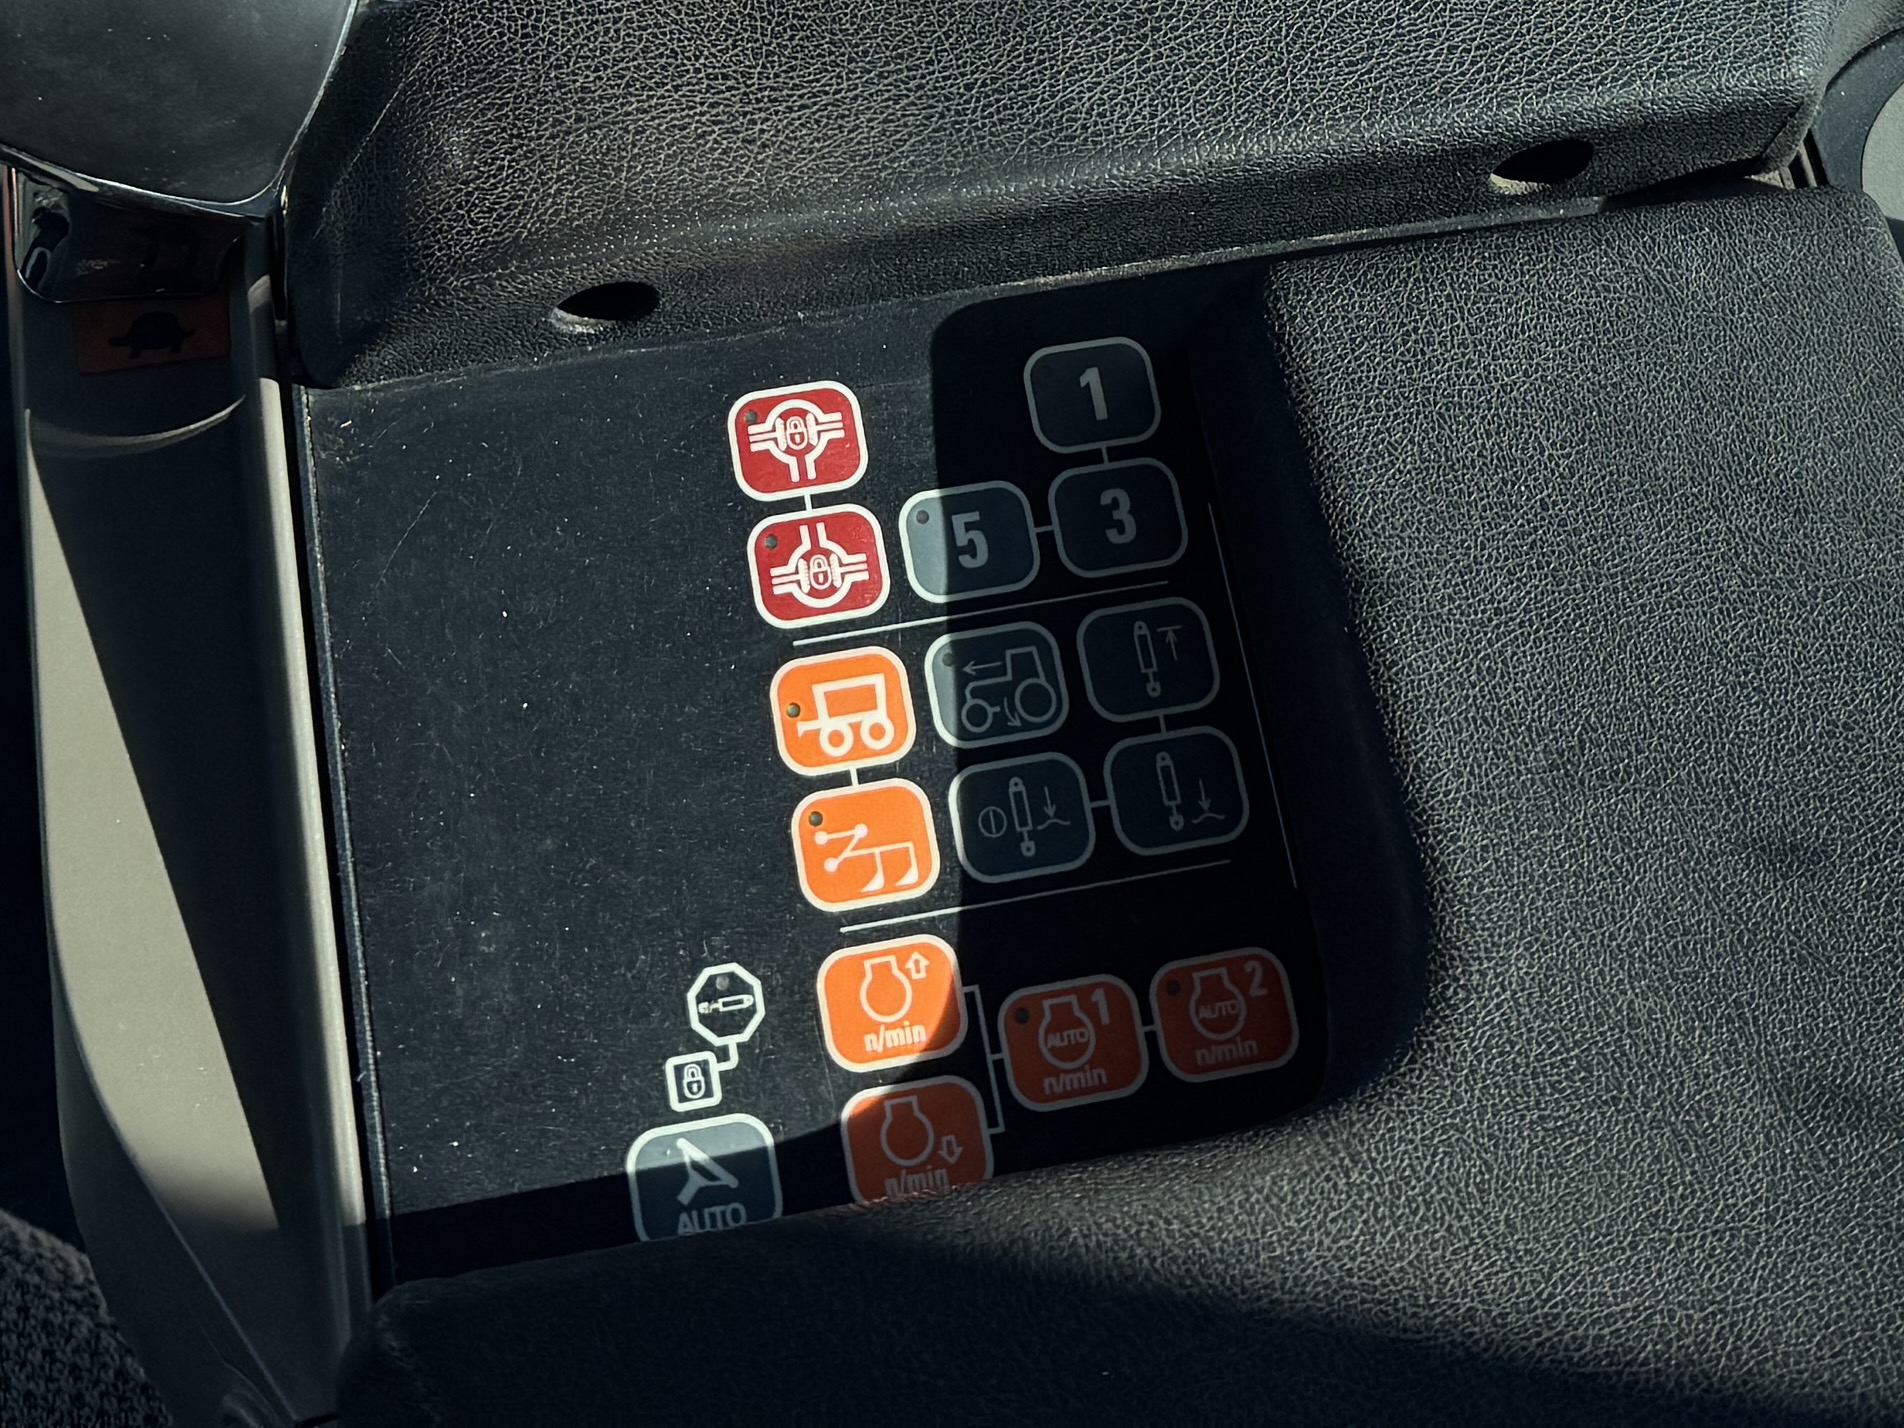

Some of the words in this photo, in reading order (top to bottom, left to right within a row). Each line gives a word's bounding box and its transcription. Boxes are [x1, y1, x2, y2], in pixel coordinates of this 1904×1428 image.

[1079, 366, 1109, 421] 1
[1099, 487, 1138, 545] 3
[951, 511, 989, 569] 5
[1244, 960, 1268, 998] 2
[1091, 987, 1110, 1025] 1
[1197, 999, 1240, 1020] AUTO
[864, 1021, 928, 1054] n/min
[1046, 1027, 1089, 1050] AUTO
[1196, 1036, 1258, 1066] n/min
[1042, 1065, 1108, 1095] n/min
[677, 1202, 746, 1236] AUTO
